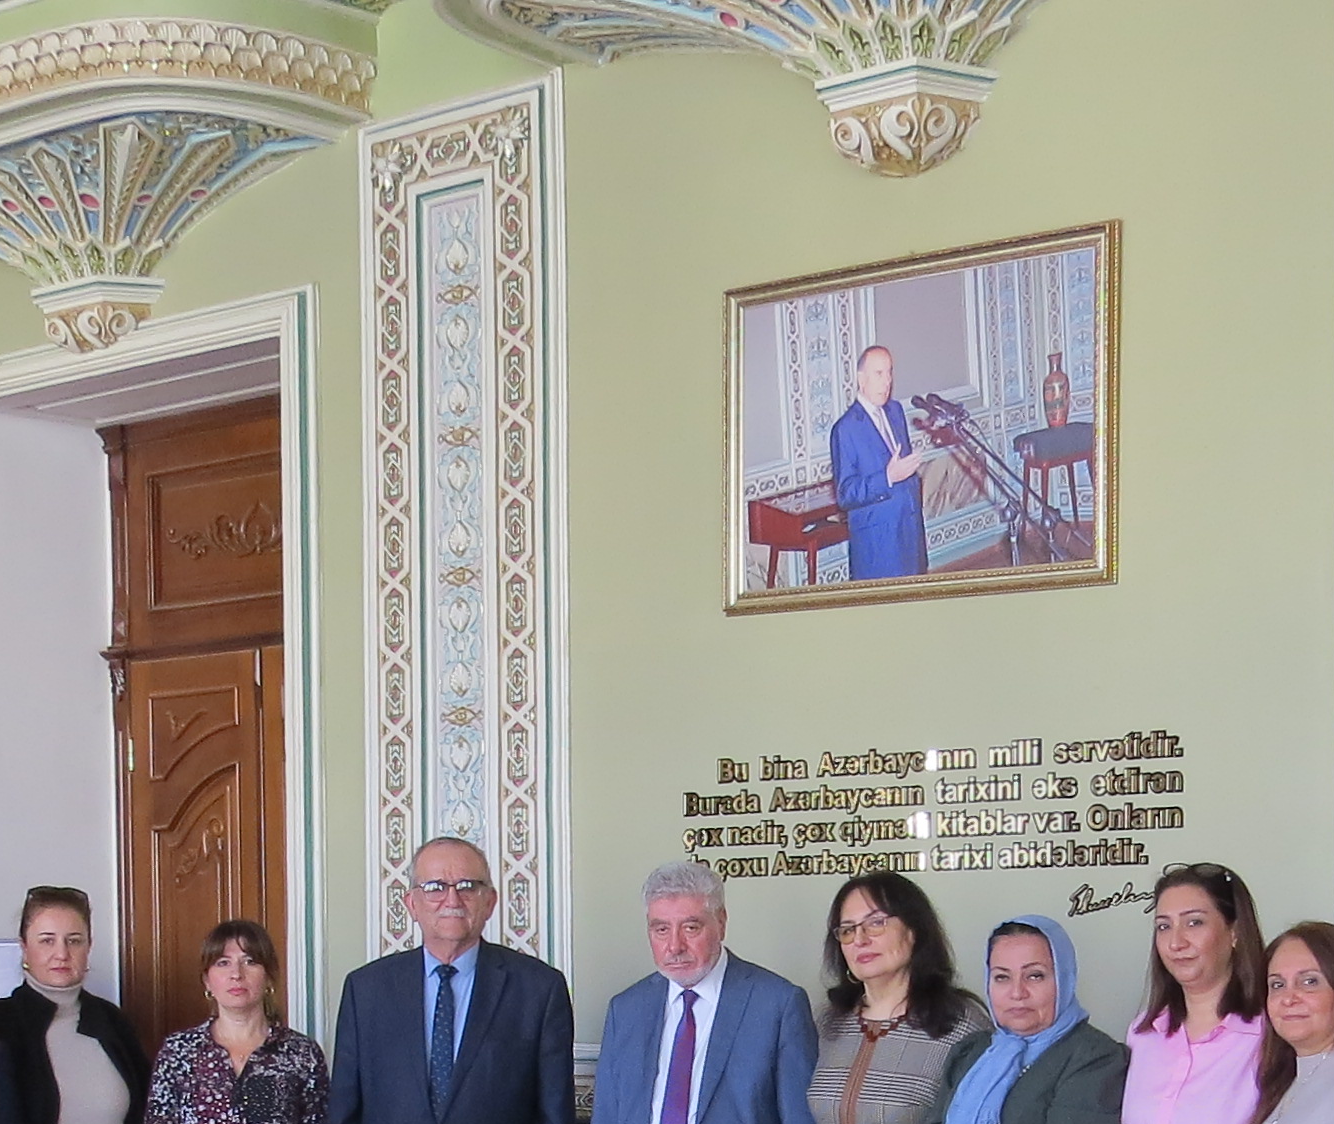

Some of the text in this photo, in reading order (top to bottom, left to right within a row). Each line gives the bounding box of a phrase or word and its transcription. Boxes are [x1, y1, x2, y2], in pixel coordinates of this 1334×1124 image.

[717, 757, 750, 784] Bu
[759, 754, 808, 781] bina
[988, 737, 1043, 768] milli
[1053, 730, 1184, 764] sərvətidir.
[682, 767, 1184, 817] Burada Azərbaycanın tarixini əks etdirən
[682, 826, 724, 853] çox
[727, 818, 788, 847] nadir,
[792, 821, 837, 849] çox
[936, 808, 1030, 837] kitablar
[1033, 808, 1081, 833] var.
[1086, 802, 1184, 831] Onların
[772, 848, 927, 879] Azərbaycanın
[931, 841, 994, 871] tarixi
[998, 837, 1149, 868] abidələridir.
